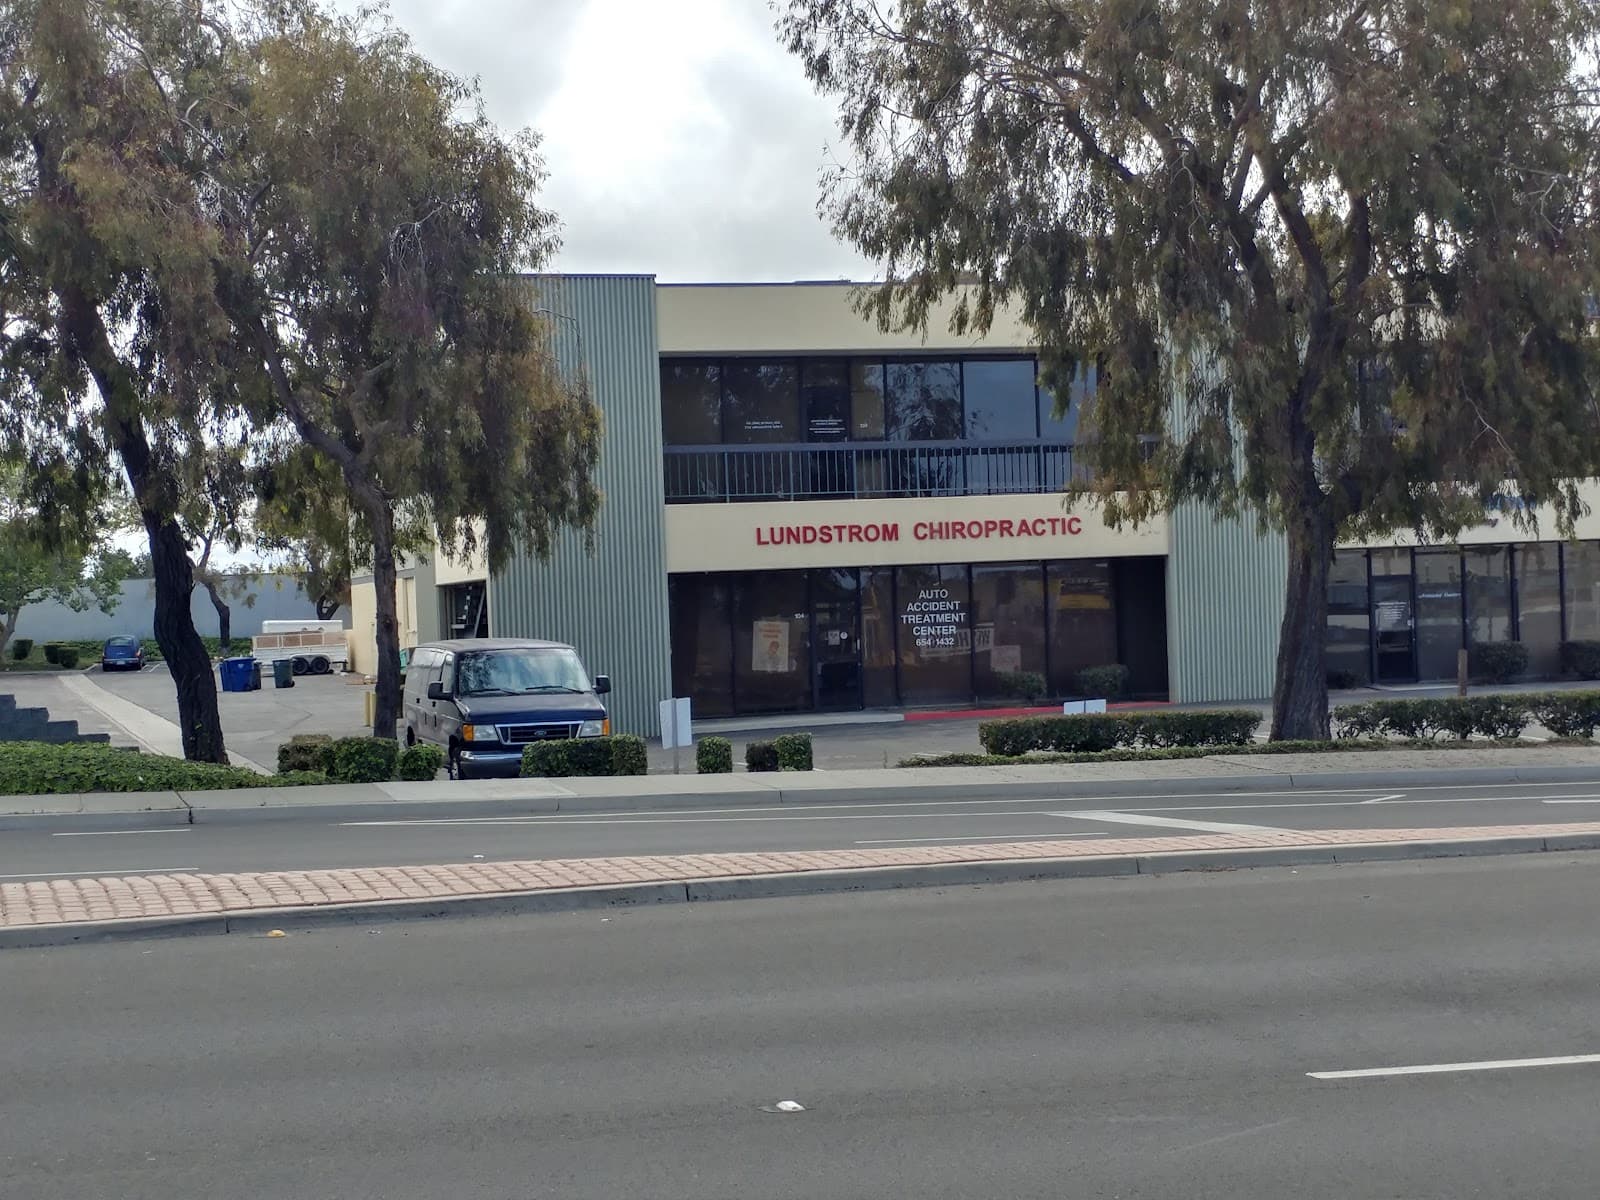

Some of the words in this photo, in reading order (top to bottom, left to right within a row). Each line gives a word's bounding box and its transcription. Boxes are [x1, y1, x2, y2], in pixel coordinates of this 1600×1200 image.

[756, 524, 899, 545] LUNDSTROM
[913, 517, 1082, 540] CHIROPRACTIC
[919, 589, 949, 599] AUTO
[907, 601, 961, 612] ACCIDENT
[901, 613, 966, 624] TREATMENT
[913, 626, 956, 636] CENTER
